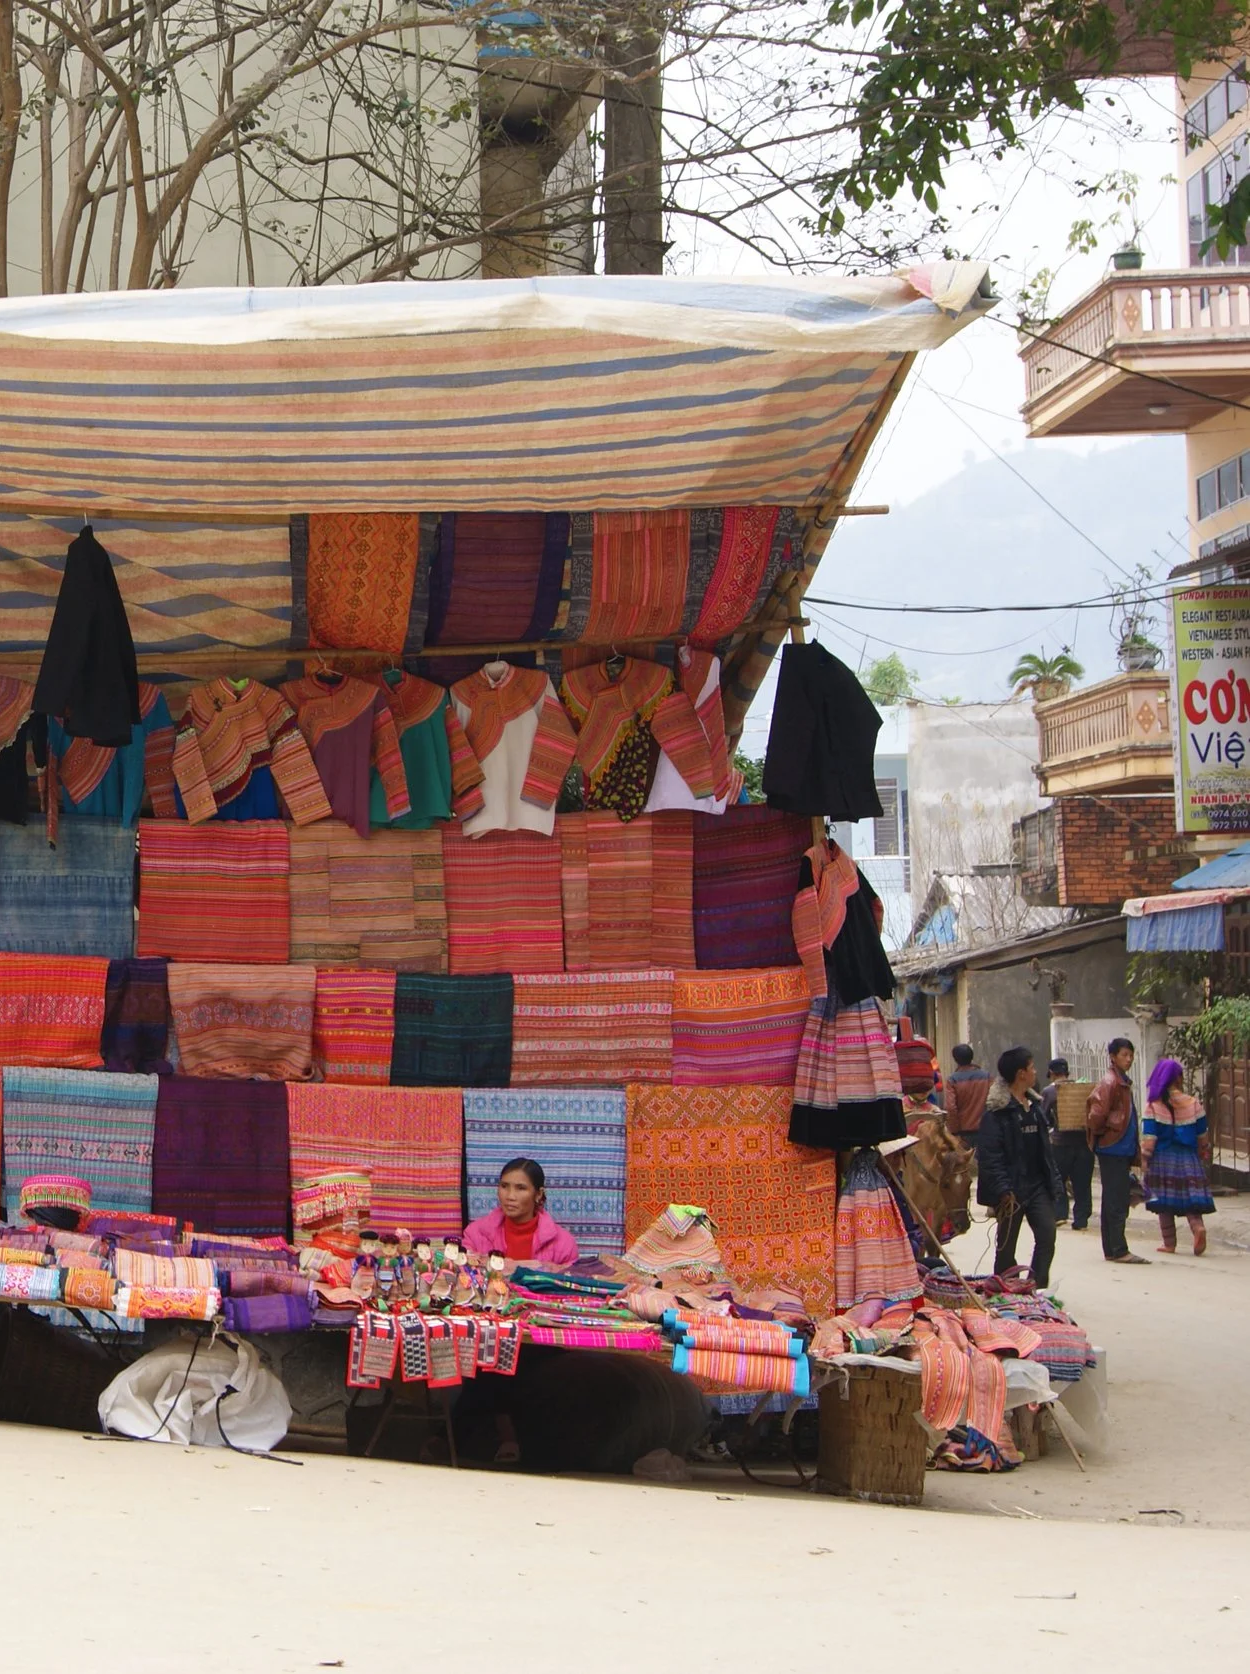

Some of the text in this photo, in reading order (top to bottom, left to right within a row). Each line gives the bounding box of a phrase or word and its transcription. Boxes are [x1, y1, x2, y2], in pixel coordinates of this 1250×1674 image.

[1213, 589, 1250, 600] BOULEVA
[1181, 610, 1213, 624] ELEGANT
[1188, 628, 1232, 641] VIETNAMESE
[1181, 647, 1214, 661] WESTERN
[1222, 647, 1243, 659] ASIAN
[1191, 731, 1250, 769] Việ
[1207, 810, 1230, 818] 0974
